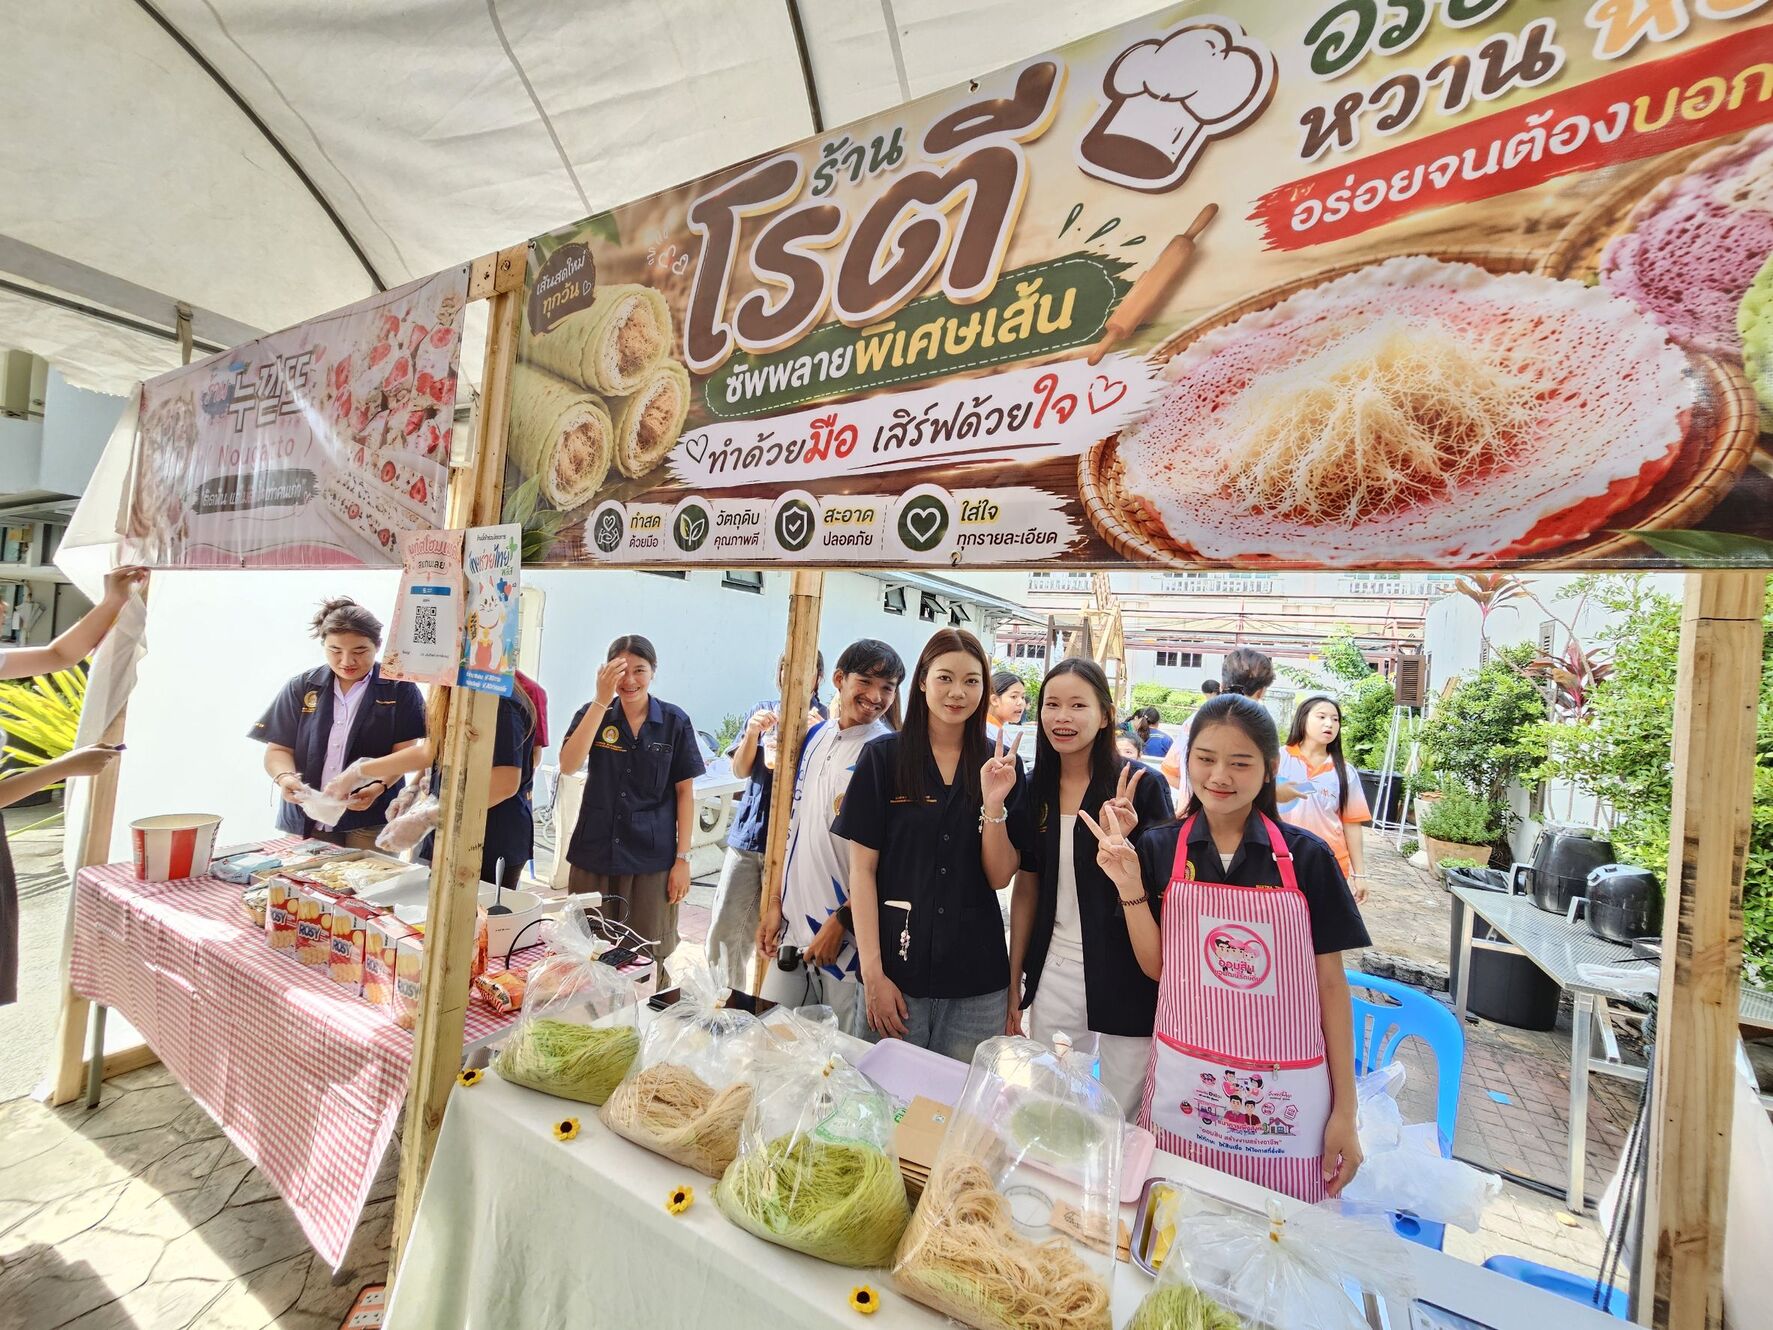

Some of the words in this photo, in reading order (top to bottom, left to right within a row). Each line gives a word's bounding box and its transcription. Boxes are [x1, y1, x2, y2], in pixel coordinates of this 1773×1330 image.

[1301, 23, 1556, 160] หวาน
[811, 127, 903, 196] ร้าน
[687, 59, 1060, 366] โรตี
[537, 249, 586, 295] เส้นสดใหม่
[543, 282, 580, 319] ทุกวัน
[708, 412, 859, 474] ทำด้วยมือ
[872, 373, 1079, 453] เสิร์ฟด้วยใจ
[630, 512, 662, 529] ทำสด
[716, 509, 760, 531] วัตถุดิบ
[823, 507, 874, 523] สะอาด
[960, 499, 999, 522] ใส่ใจ
[629, 533, 659, 549] ด้วยมือ
[713, 532, 760, 550] คุณภาพดี
[823, 530, 874, 547] ปลอดภัย
[956, 527, 1058, 552] ทุกรายละเอียด
[299, 924, 321, 941] ROSY
[333, 937, 351, 956] ROSY
